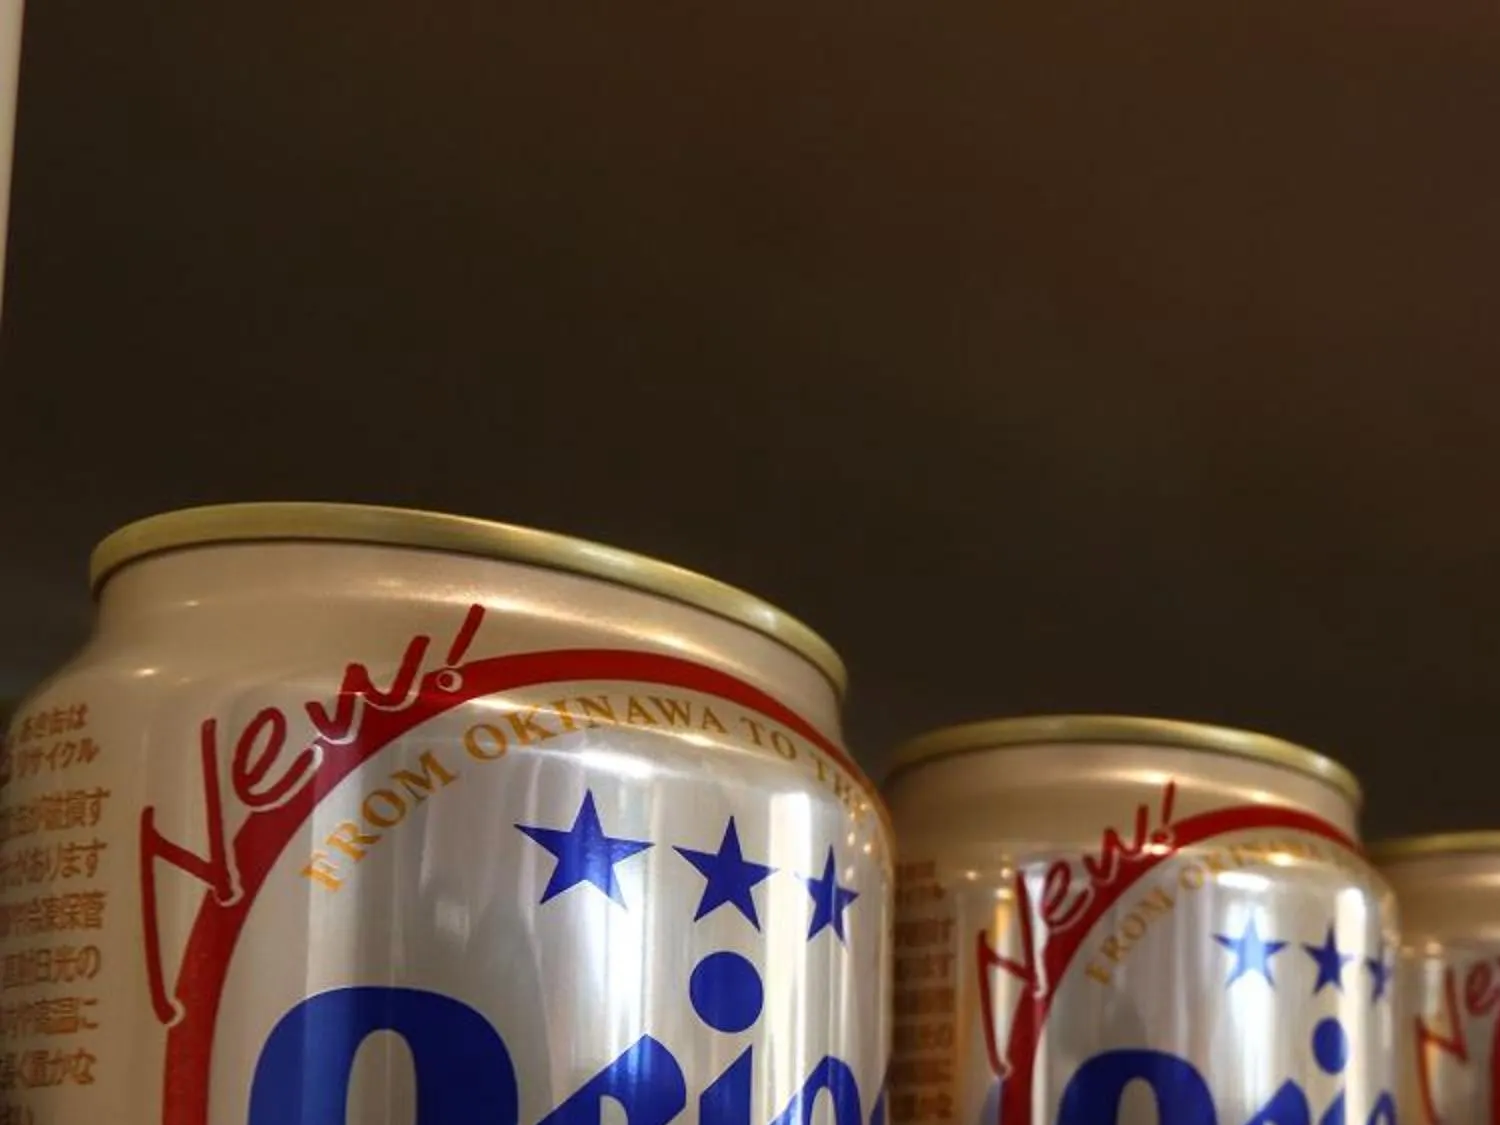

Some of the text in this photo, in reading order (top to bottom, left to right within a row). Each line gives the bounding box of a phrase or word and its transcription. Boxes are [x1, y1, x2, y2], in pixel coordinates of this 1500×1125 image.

[141, 604, 485, 1025] New!
[299, 750, 459, 894] FROM
[463, 694, 728, 763] OKINAWA
[740, 717, 797, 761] TO
[977, 780, 1176, 1077] New!
